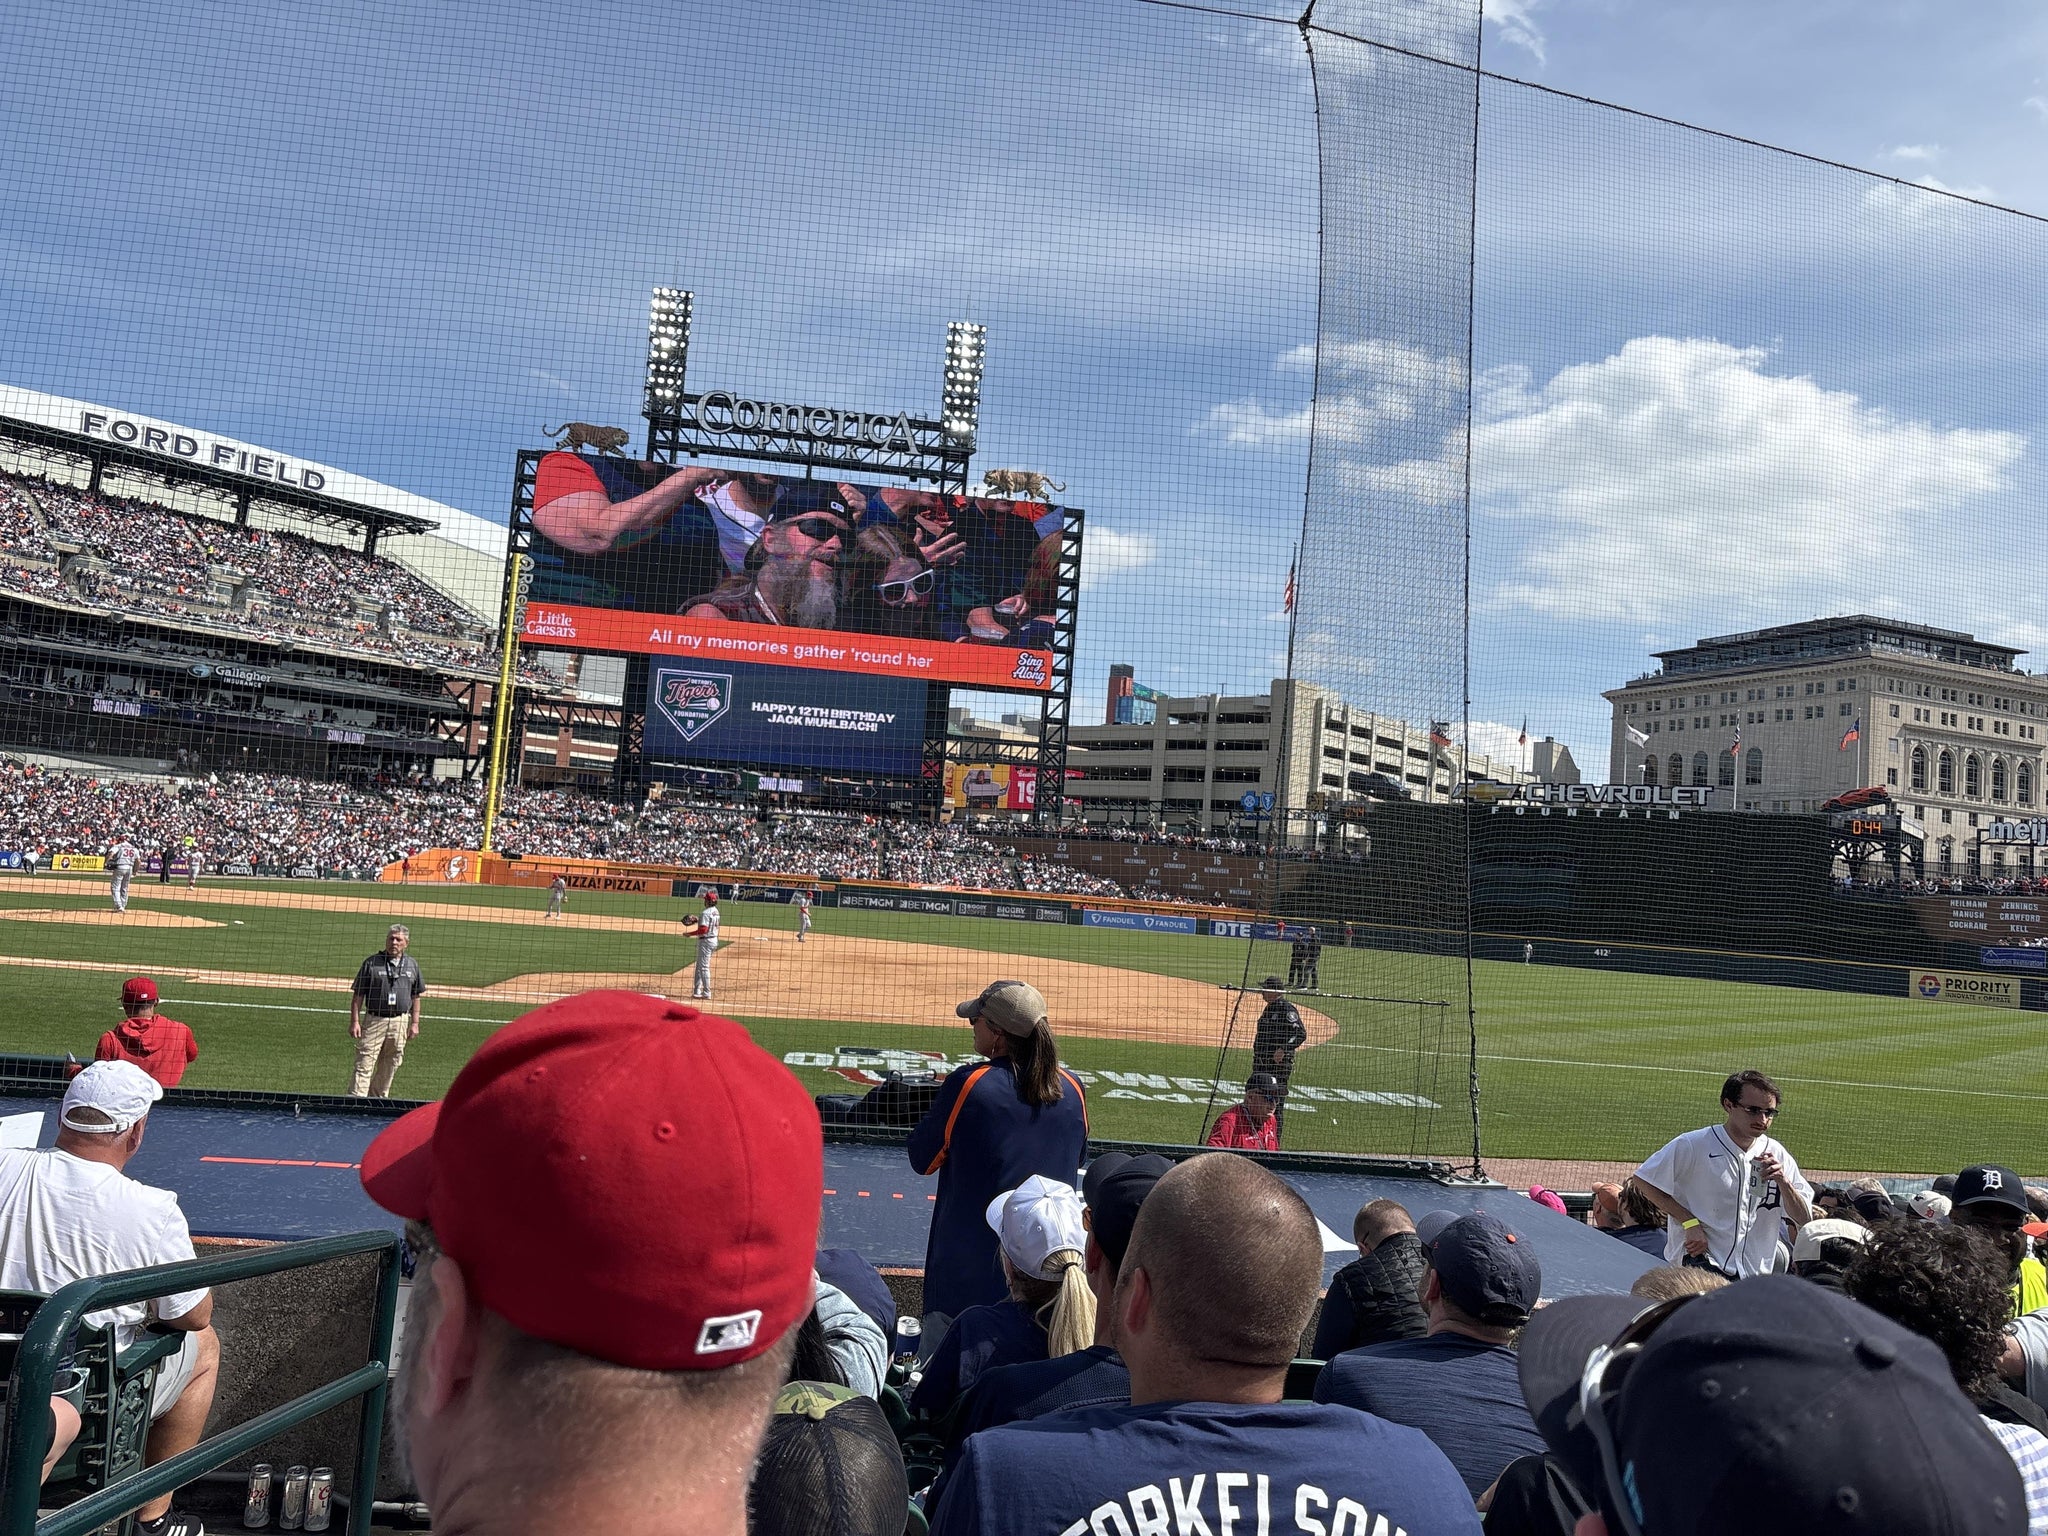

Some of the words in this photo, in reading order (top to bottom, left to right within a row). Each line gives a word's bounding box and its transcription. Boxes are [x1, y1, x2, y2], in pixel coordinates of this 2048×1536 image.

[696, 389, 921, 455] Comerica
[79, 410, 199, 458] FORD
[210, 442, 327, 492] FIELD
[756, 435, 861, 462] PARK
[512, 573, 534, 634] Rocket
[538, 610, 573, 627] Little
[526, 620, 577, 638] Caesars
[648, 628, 672, 644] All
[677, 633, 702, 649] my
[707, 636, 789, 655] memories
[793, 644, 847, 660] gather
[851, 648, 902, 666] 'round
[907, 653, 933, 668] her
[1017, 651, 1044, 671] Sing
[214, 665, 272, 683] Gallagher
[1011, 666, 1047, 686] Along
[223, 677, 262, 689] INSURANCE
[664, 677, 720, 709] Tigers
[93, 699, 113, 713] SING
[114, 701, 141, 717] ALONG
[673, 710, 709, 719] FOUNDATION
[752, 702, 797, 716] HAPPY
[798, 705, 829, 718] 12TH
[830, 708, 896, 724] BIRTHDAY
[767, 713, 803, 727] JACK
[804, 716, 878, 732] MUHLBACH!
[327, 729, 343, 742] SING
[343, 732, 366, 745] ALONG
[758, 776, 778, 792] SING
[778, 778, 803, 793] ALONG
[1525, 782, 1715, 807] CHEVROLET
[1491, 805, 1680, 820] FOUNTAIN
[1852, 820, 1882, 835] 0:44
[1057, 842, 1067, 851] 23
[1133, 847, 1138, 856] 5
[122, 849, 135, 858] 36
[1172, 852, 1178, 861] 2
[72, 856, 98, 865] PRIORITY
[1213, 856, 1222, 865] 16
[1258, 861, 1264, 871] 6
[1148, 868, 1159, 877] 47
[1191, 873, 1197, 882] 3
[558, 875, 601, 889] PIZZA!
[603, 878, 647, 893] PIZZA!
[764, 890, 779, 899] TIME
[850, 897, 894, 908] BETMGM
[907, 900, 950, 912] BETMGM
[1950, 900, 1988, 909] HEILMANN
[2001, 901, 2039, 911] JENNINGS
[1102, 916, 1136, 925] FANDUEL
[1952, 910, 1985, 919] MANUSH
[1999, 913, 2041, 923] CRAWFORD
[1155, 920, 1189, 929] FANDUEL
[1215, 921, 1251, 938] DTE
[1949, 920, 1988, 931] COCHRANE
[2010, 923, 2029, 933] KELL
[1945, 978, 2011, 995] PRIORITY
